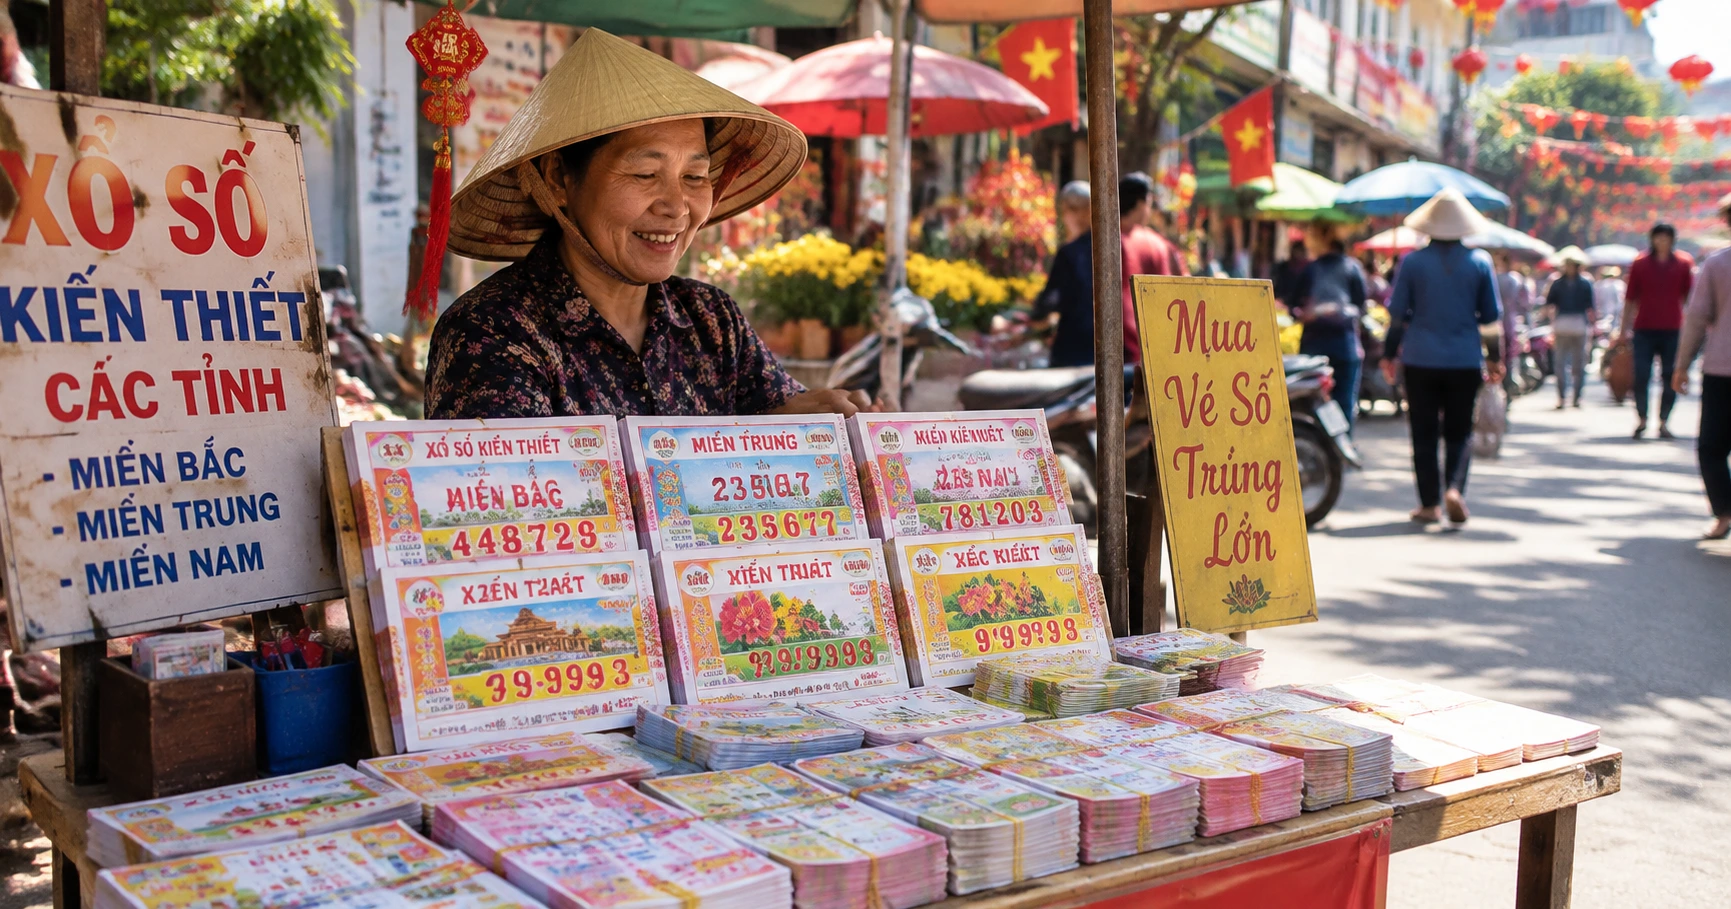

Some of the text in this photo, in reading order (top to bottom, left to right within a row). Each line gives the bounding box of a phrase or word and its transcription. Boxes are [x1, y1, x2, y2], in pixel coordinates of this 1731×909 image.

[165, 140, 268, 258] SỐ
[0, 264, 305, 343] KIẾN THIẾT
[172, 352, 287, 416] TỈNH
[1164, 372, 1218, 429] Vé
[172, 492, 281, 530] TRUNG
[939, 500, 1044, 530] 781203
[189, 541, 265, 579] NAM
